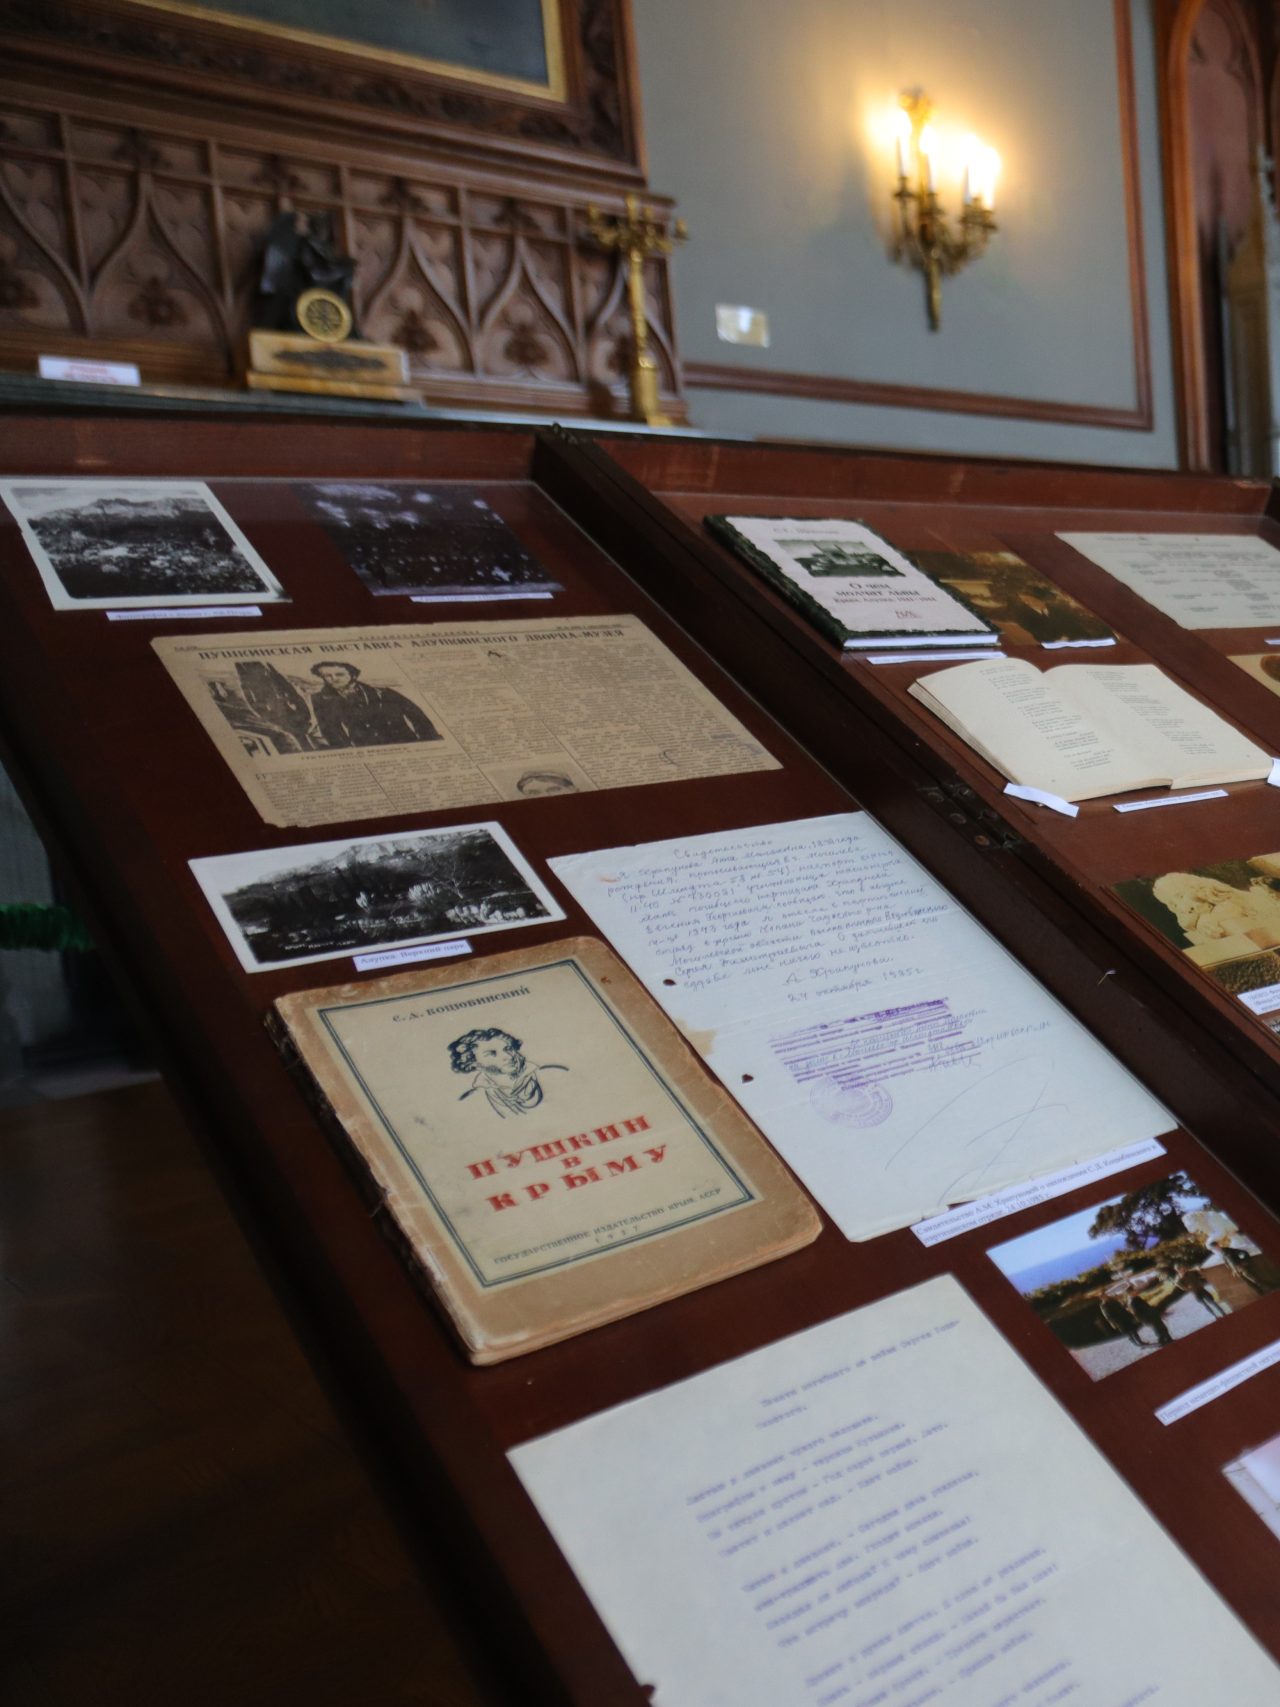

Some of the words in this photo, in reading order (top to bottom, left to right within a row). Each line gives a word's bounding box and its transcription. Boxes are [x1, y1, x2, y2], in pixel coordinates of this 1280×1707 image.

[198, 645, 313, 661] ПУШКИНСКАЯ
[320, 639, 402, 654] ВЫСТАВКА
[411, 634, 519, 649] АЛУПКИНСКОГО
[525, 628, 625, 643] ДВОРЦА-МУЗЕЯ
[465, 1115, 652, 1180] ПУШКИН
[485, 1144, 668, 1213] КРЫМУ
[493, 1231, 591, 1265] ГОСУДАРСТВЕННОЕ
[593, 1207, 666, 1235] ИЗДАТЕЛЬСТВО
